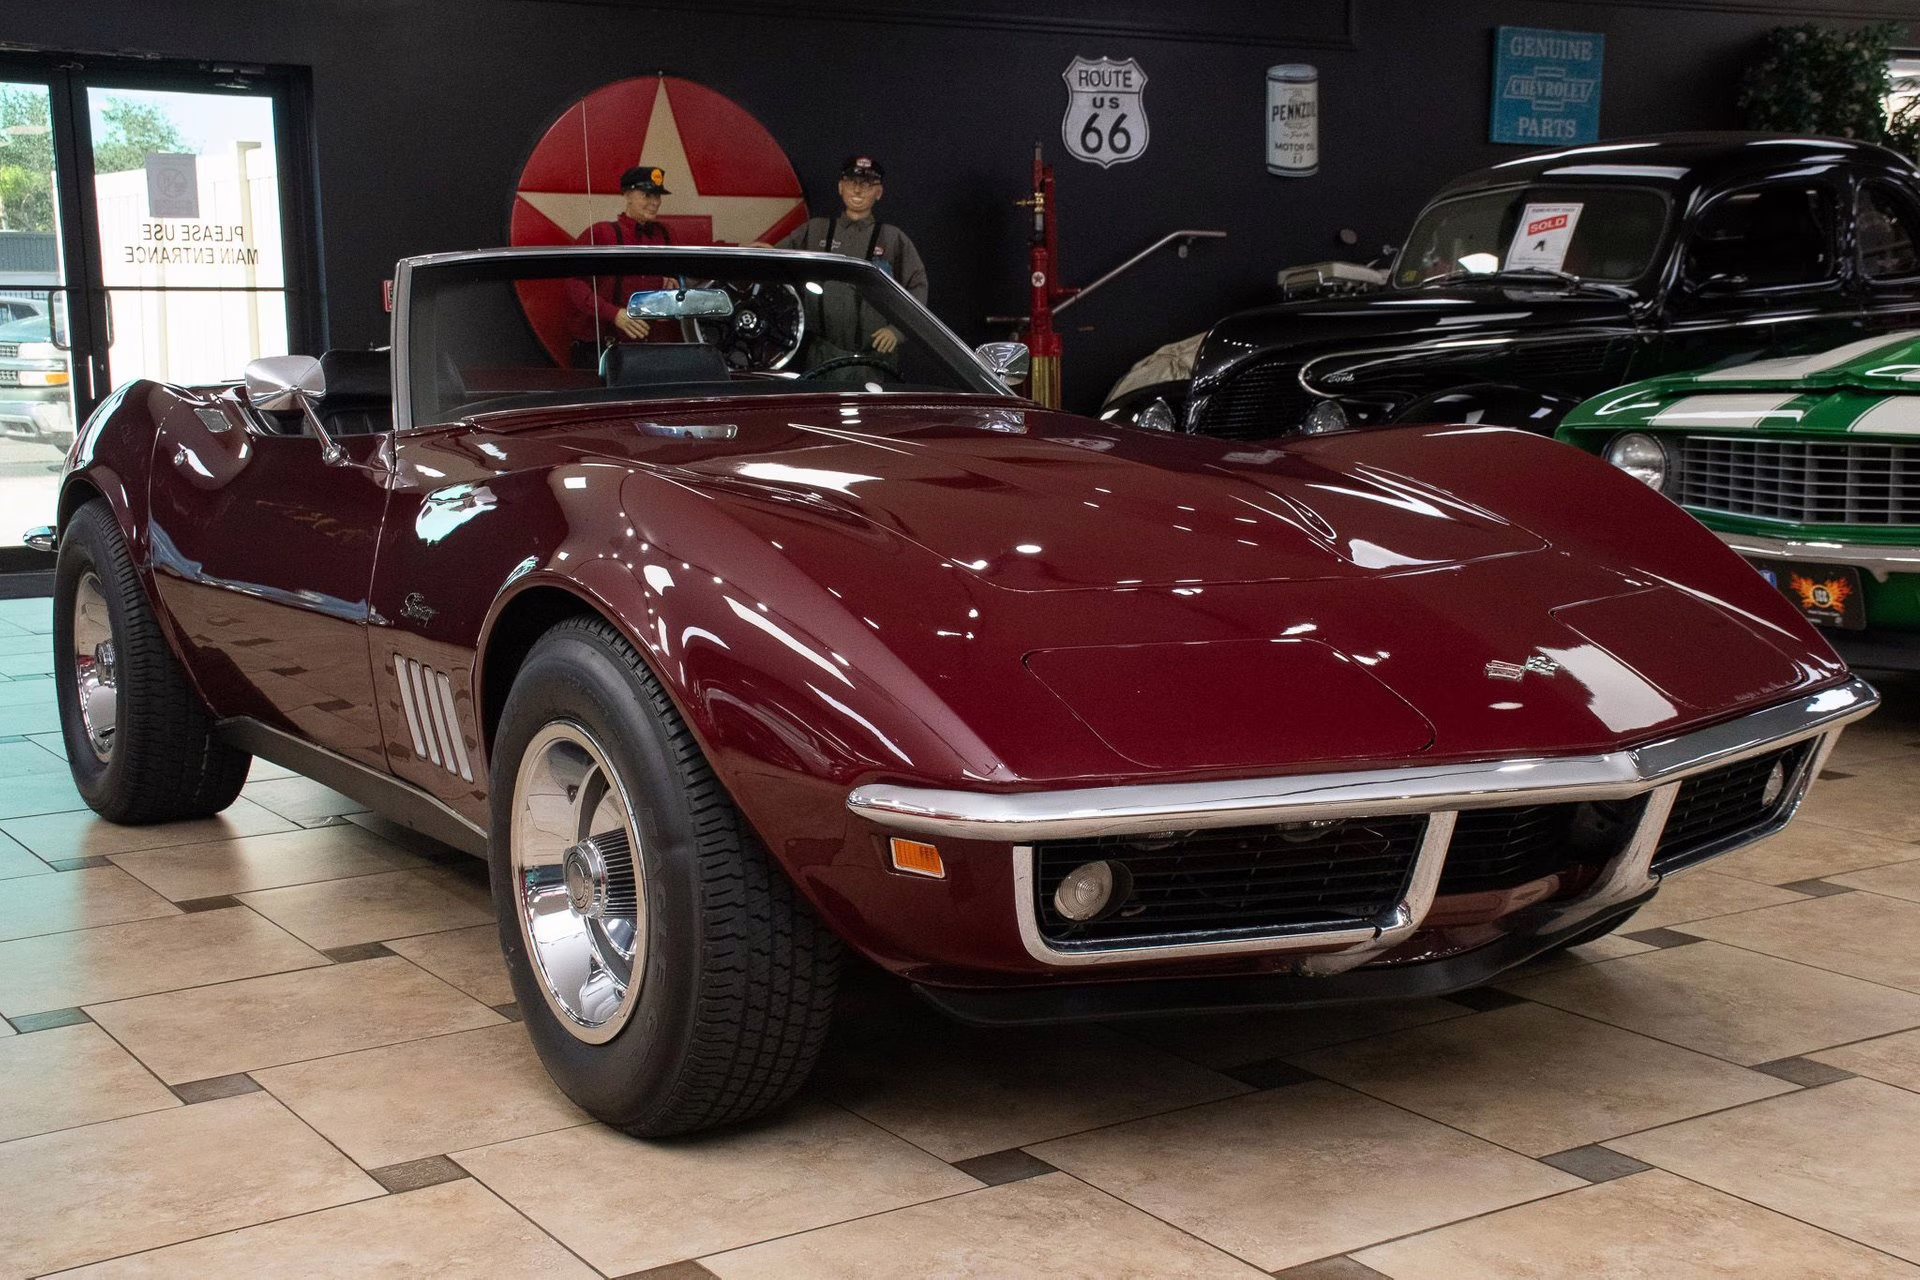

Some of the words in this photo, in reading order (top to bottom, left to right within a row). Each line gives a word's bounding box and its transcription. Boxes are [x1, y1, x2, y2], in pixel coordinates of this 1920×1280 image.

[1510, 36, 1593, 60] GENUINE
[1078, 69, 1133, 88] ROUTE
[1510, 79, 1589, 99] CHEVROLET
[1092, 96, 1120, 109] US
[1080, 112, 1132, 154] 66
[1516, 116, 1577, 138] PARTS
[1274, 142, 1305, 152] MOTOR
[1529, 217, 1565, 233] SOLD
